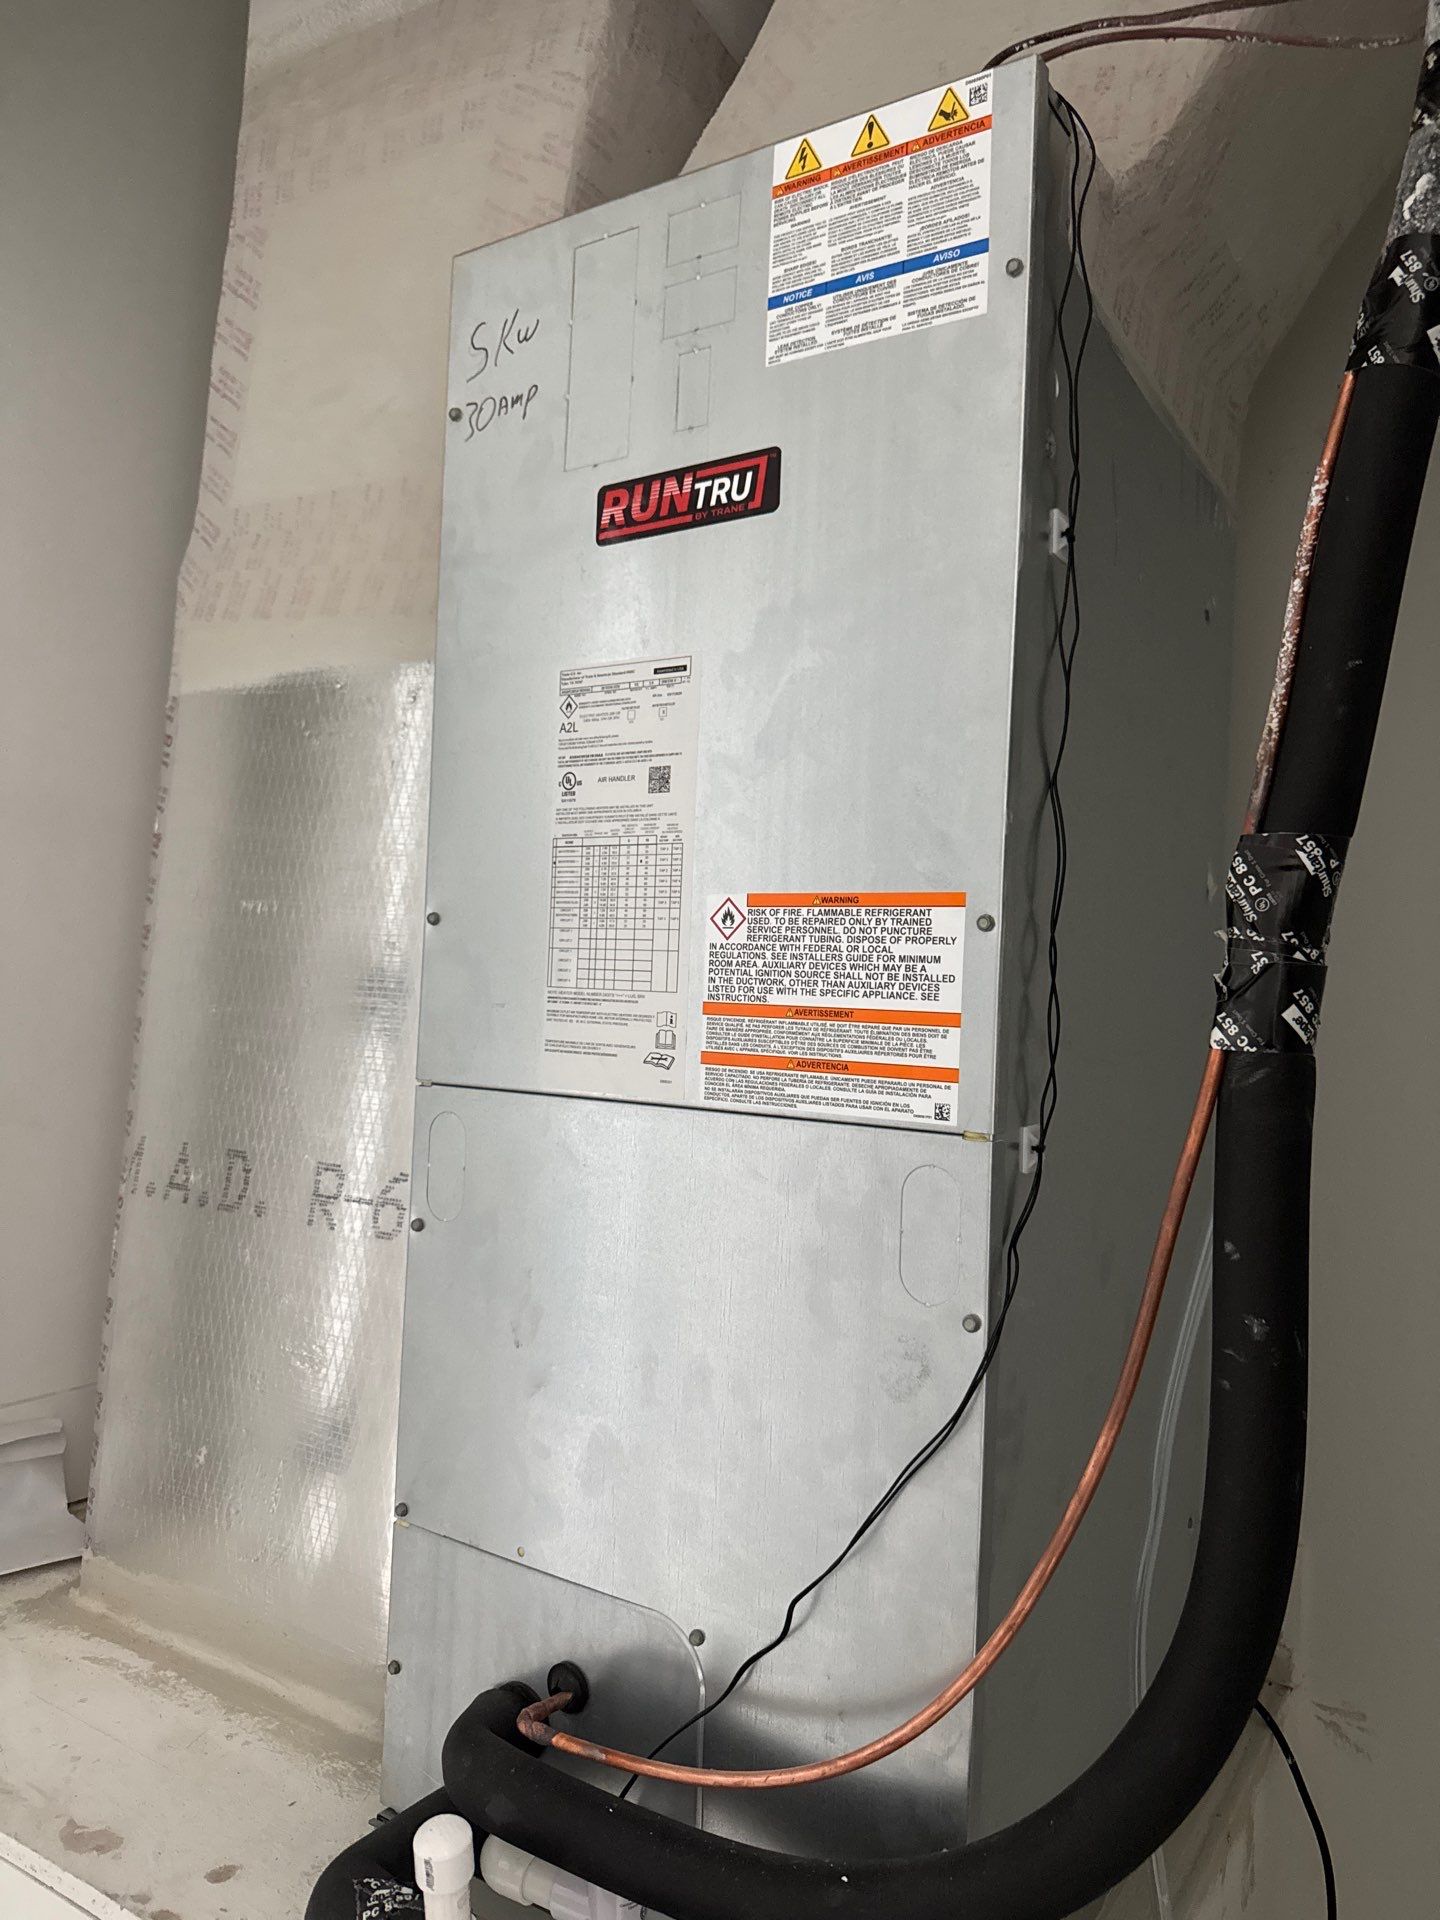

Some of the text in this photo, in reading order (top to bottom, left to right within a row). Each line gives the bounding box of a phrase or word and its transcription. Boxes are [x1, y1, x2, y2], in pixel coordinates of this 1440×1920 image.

[922, 119, 985, 146] ADVERTENCIA
[842, 145, 903, 173] AVERTISSEMENT
[784, 173, 821, 192] WARNING
[932, 247, 960, 263] AVISO
[1399, 250, 1423, 273] 857
[855, 270, 874, 283] AVIS
[782, 288, 812, 303] NOTICE
[695, 504, 747, 521] BY TRANE
[559, 721, 579, 734] A2L
[597, 774, 636, 784] AIR HANDLER
[1242, 874, 1262, 896] PC
[898, 955, 941, 963] MINIMUM
[902, 974, 955, 982] INSTALLED
[819, 989, 859, 997] SPECIFIC
[847, 981, 896, 989] AUXILIARY
[898, 983, 940, 991] DEVICES
[1292, 988, 1314, 1013] 857
[794, 1008, 854, 1019] AVERTISSEMENT
[1216, 1011, 1239, 1036] 857
[796, 1060, 849, 1072] ADVERTENCIA
[307, 1161, 410, 1241] R-6
